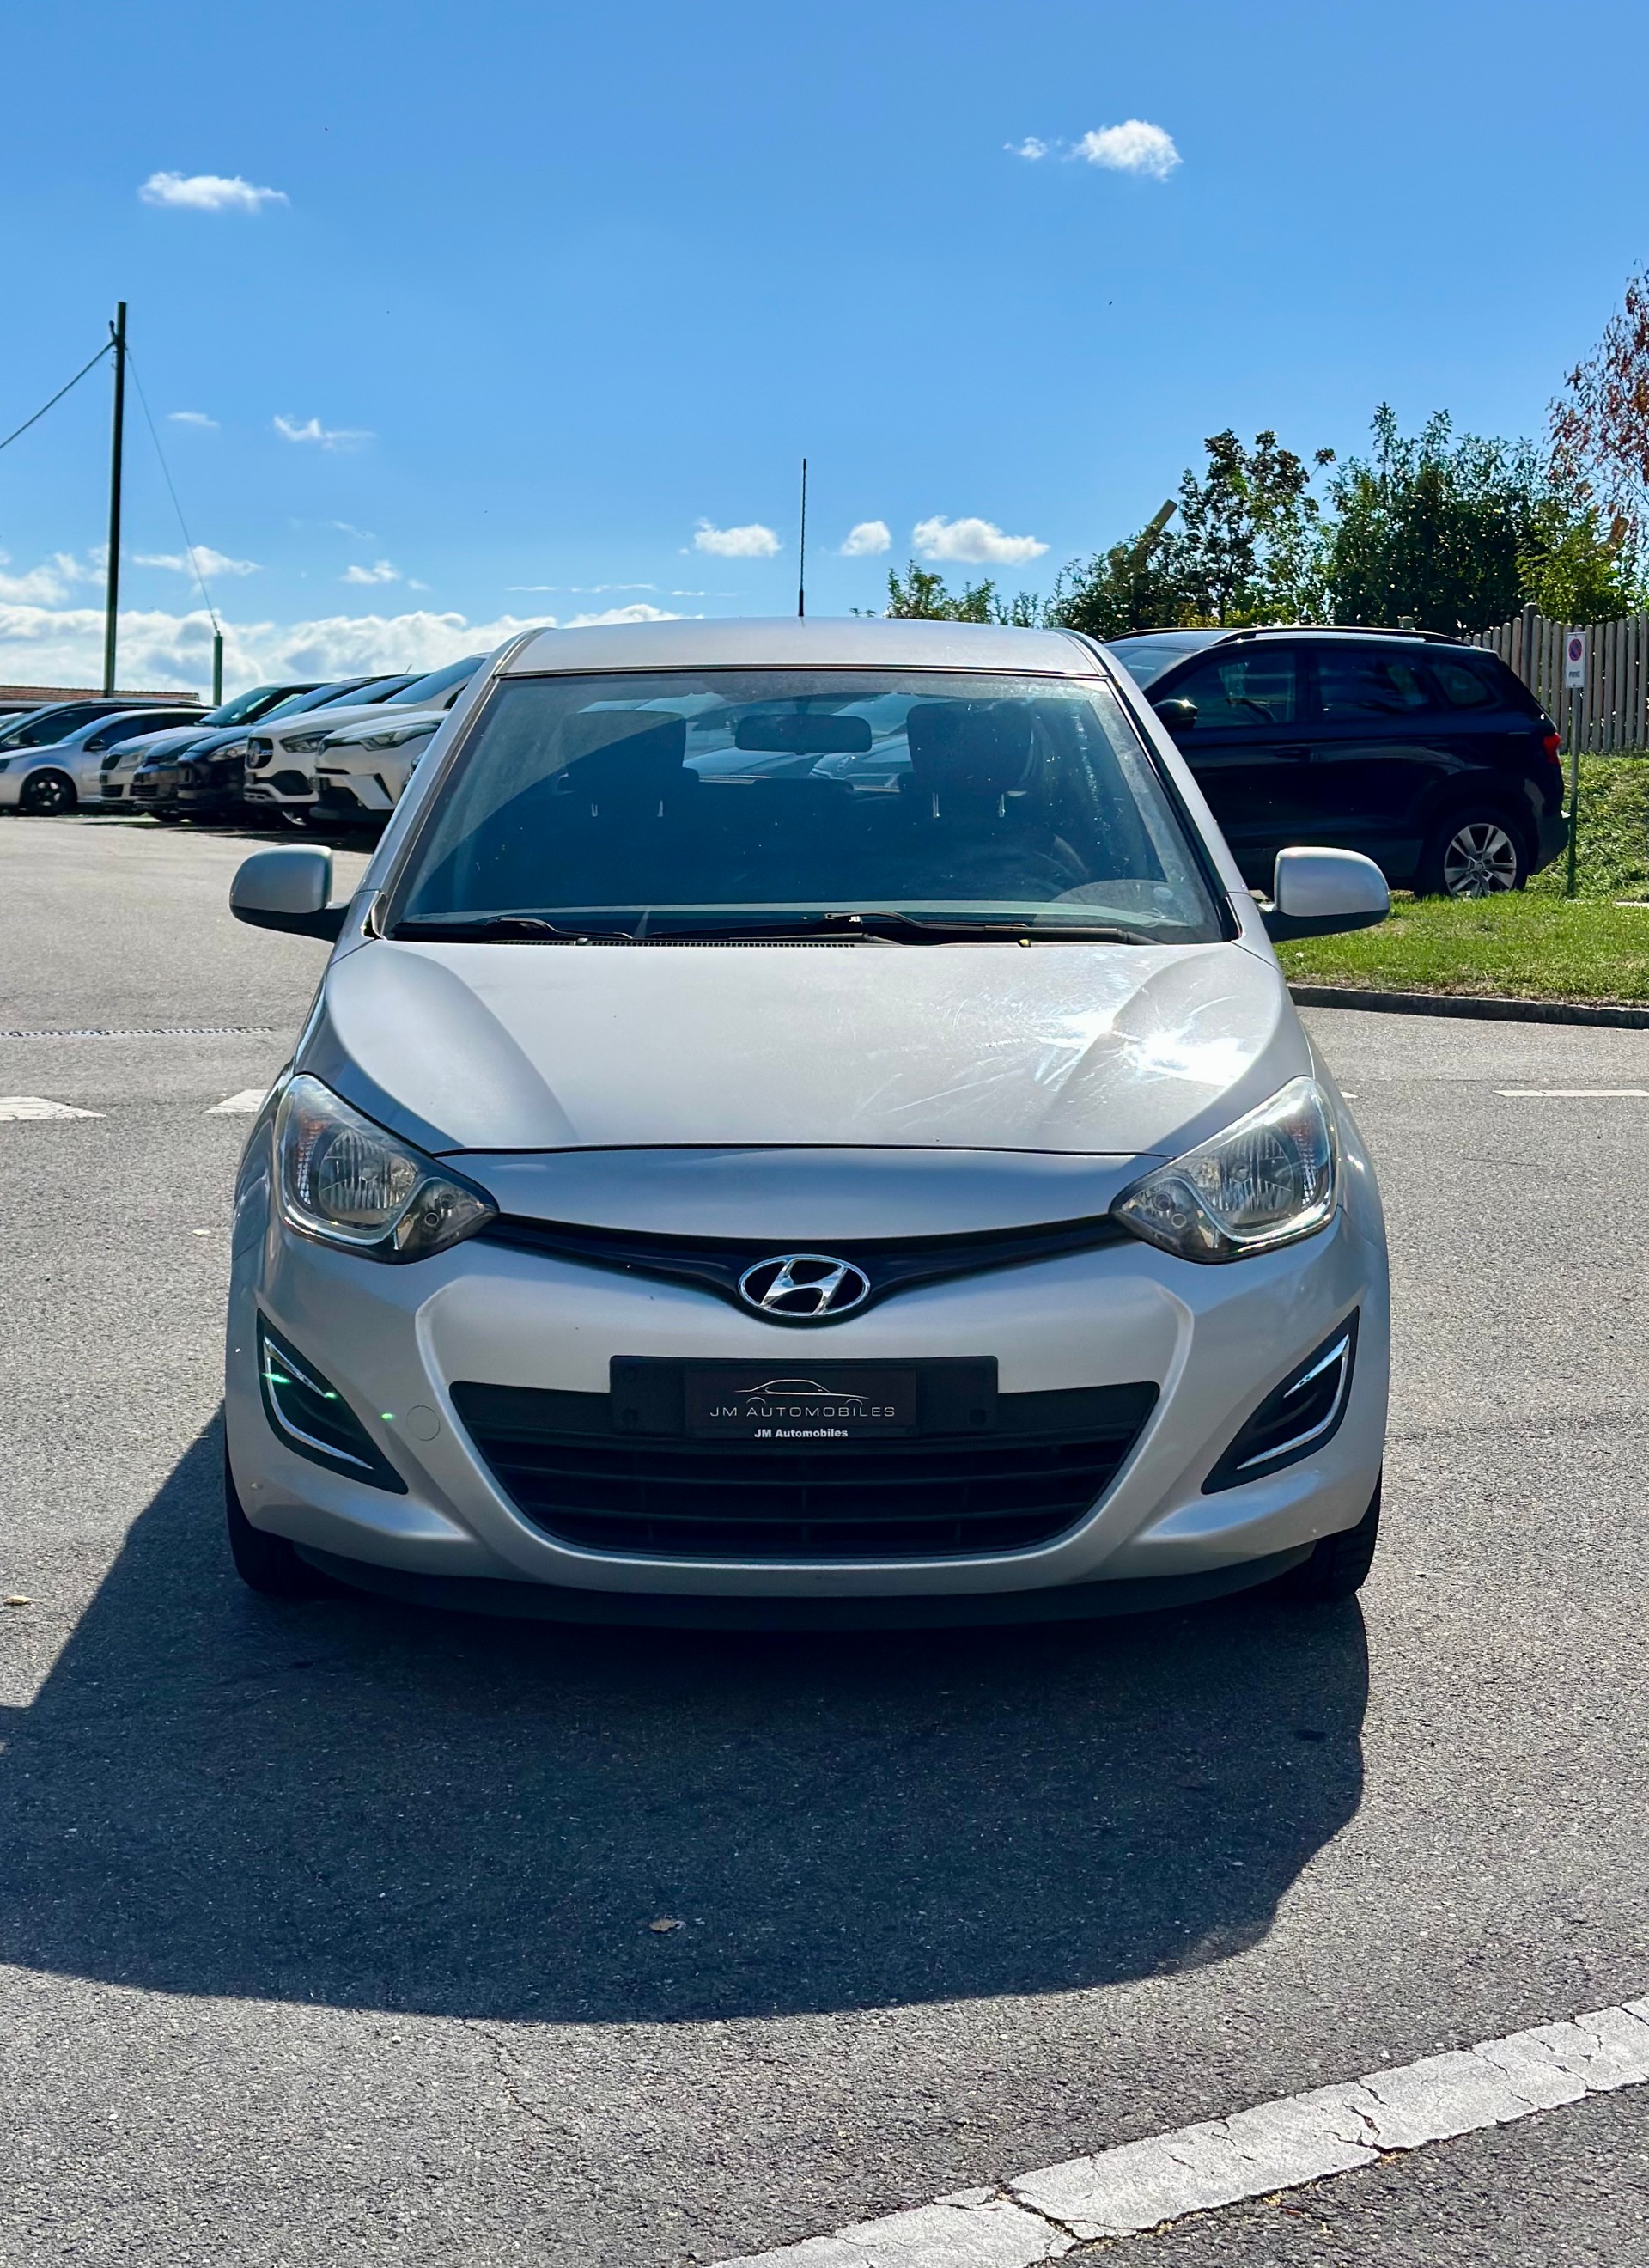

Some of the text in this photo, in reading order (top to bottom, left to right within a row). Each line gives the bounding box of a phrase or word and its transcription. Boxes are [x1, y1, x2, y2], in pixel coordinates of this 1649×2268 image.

[709, 1406, 895, 1417] JM AUTOMOBILES
[753, 1428, 849, 1438] JM Automobiles
